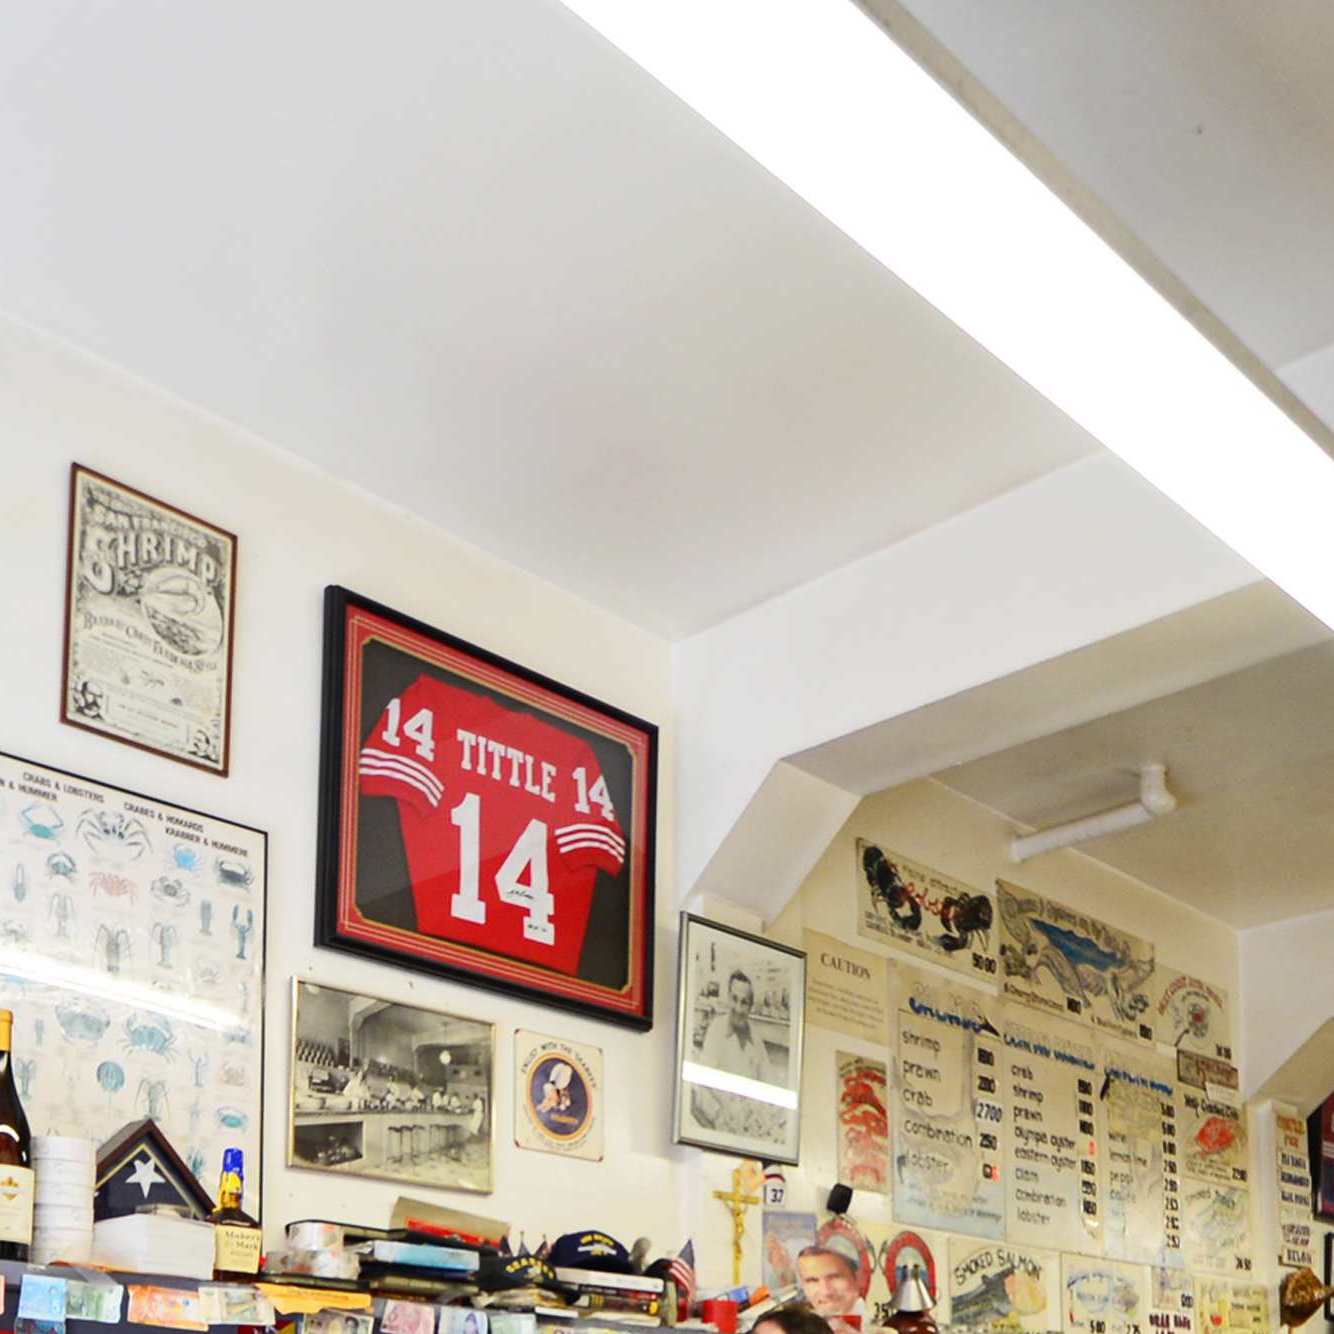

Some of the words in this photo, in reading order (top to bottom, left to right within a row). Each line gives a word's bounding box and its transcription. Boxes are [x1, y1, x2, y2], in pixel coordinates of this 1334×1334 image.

[83, 526, 218, 595] SHRIMP
[381, 697, 436, 762] 14
[456, 728, 558, 803] TITTLE
[570, 764, 616, 823] 14
[449, 792, 557, 946] 14
[820, 951, 872, 980] CAUTION
[902, 1087, 933, 1107] crab
[770, 1188, 784, 1204] 37
